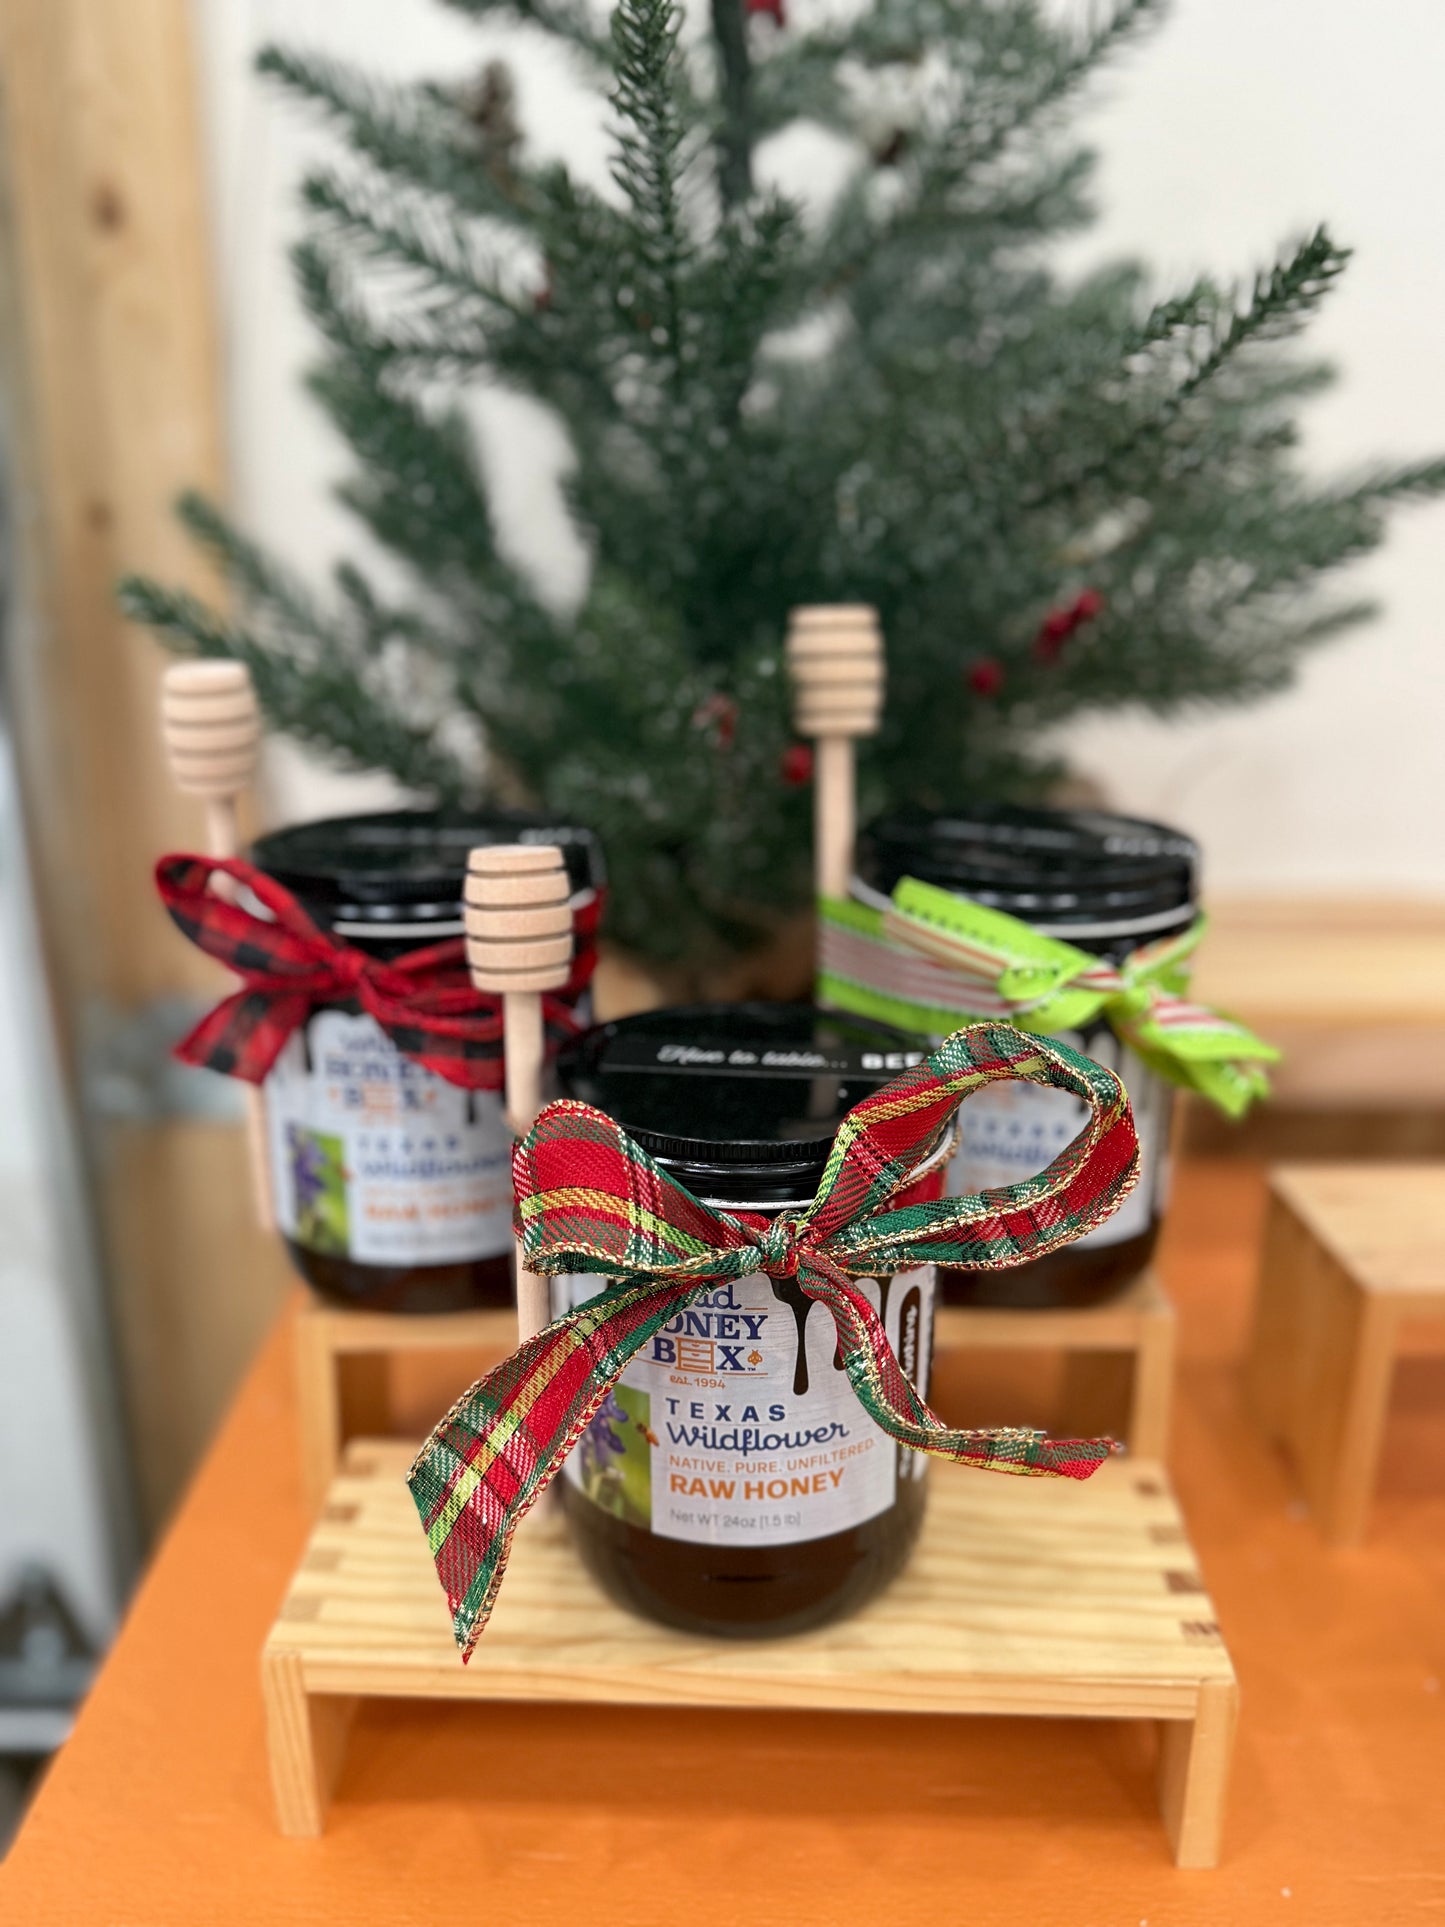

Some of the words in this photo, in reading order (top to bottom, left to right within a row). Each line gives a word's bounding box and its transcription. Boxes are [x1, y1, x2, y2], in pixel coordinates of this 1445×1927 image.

[728, 1049, 758, 1066] to
[663, 1310, 769, 1340] ONEY
[694, 1377, 726, 1390] 1994
[665, 1397, 786, 1422] TEXAS
[666, 1422, 850, 1457] Wildflower
[669, 1454, 731, 1473] NATIVE.
[735, 1461, 783, 1474] PURE.
[669, 1472, 736, 1500] RAW
[744, 1466, 845, 1501] HONEY
[670, 1508, 694, 1525] Net
[697, 1512, 719, 1526] WT
[722, 1514, 757, 1529] 24oz
